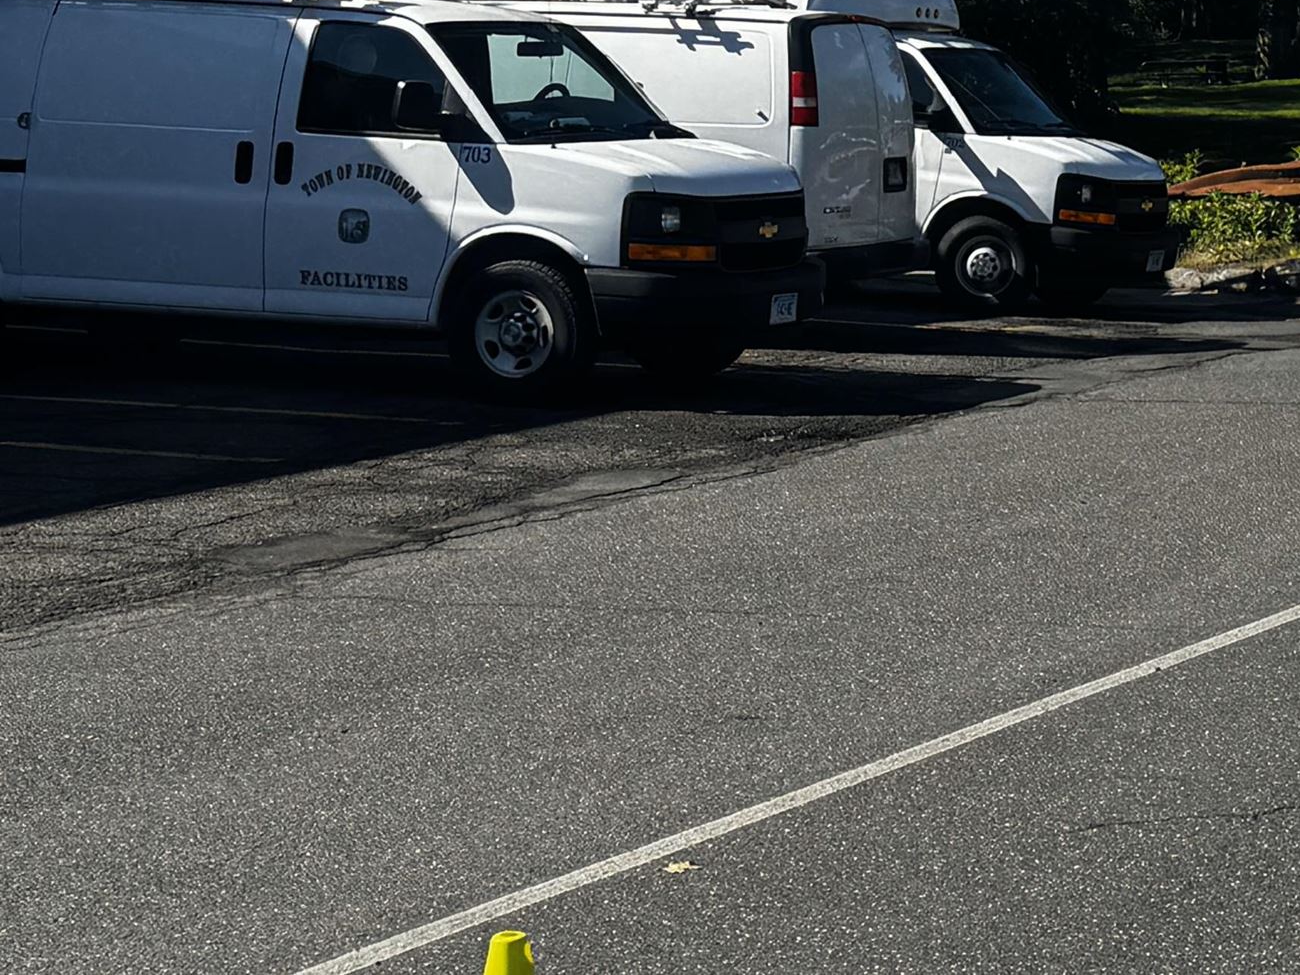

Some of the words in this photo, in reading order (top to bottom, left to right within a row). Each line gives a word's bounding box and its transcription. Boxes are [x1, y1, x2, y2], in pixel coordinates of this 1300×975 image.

[463, 145, 492, 164] 703
[301, 169, 334, 197] TOWN
[336, 164, 353, 181] OF
[356, 163, 422, 205] NEWINGTON
[300, 270, 409, 291] FACILITIES
